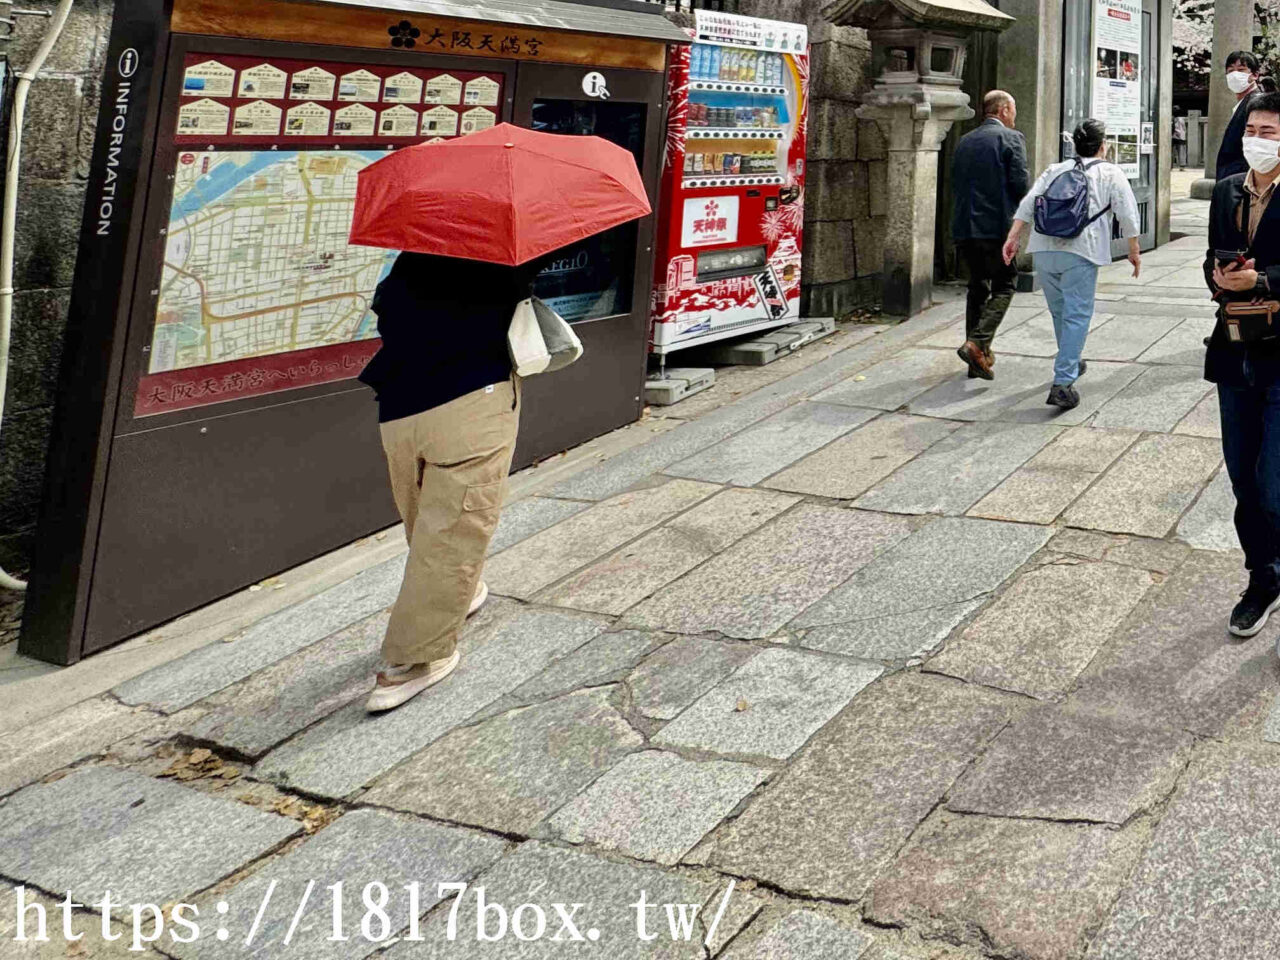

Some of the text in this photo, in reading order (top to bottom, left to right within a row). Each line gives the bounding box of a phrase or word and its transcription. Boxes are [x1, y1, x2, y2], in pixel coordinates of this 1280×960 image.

[425, 27, 544, 57] 大阪天満宮
[96, 81, 132, 236] INFORMATION
